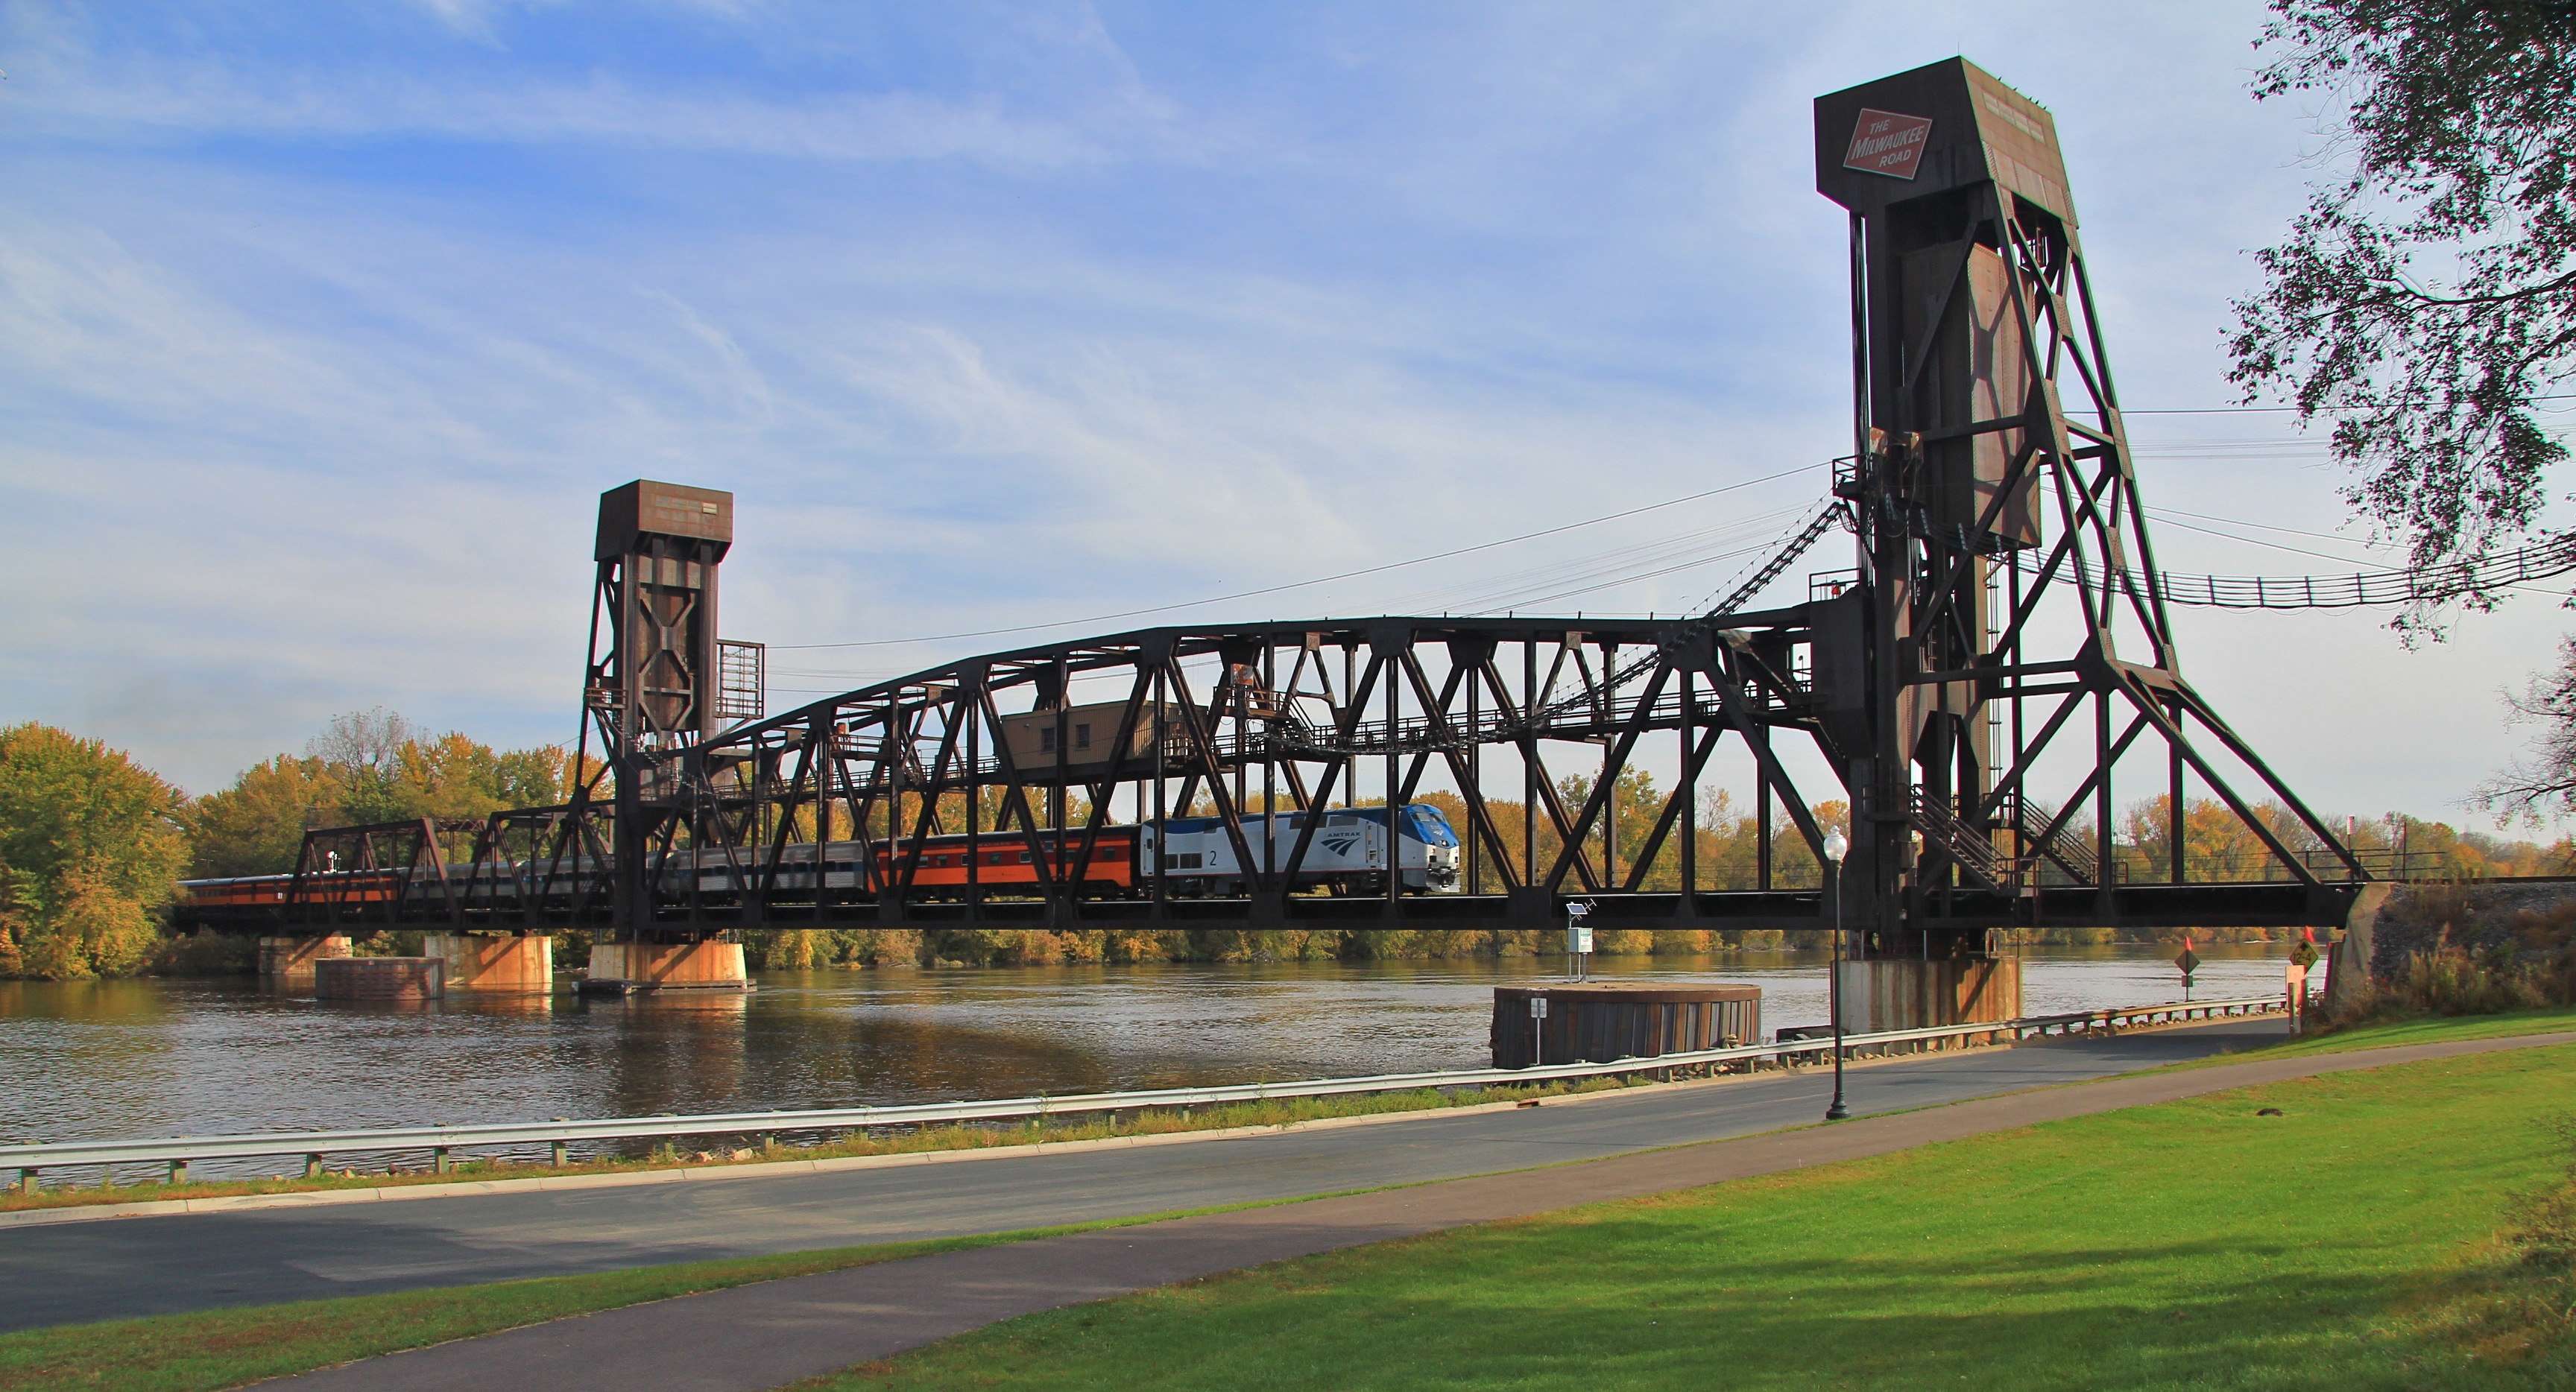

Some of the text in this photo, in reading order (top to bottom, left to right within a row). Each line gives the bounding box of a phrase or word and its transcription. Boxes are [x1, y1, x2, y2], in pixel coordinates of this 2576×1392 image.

[1869, 119, 1890, 134] THE
[1851, 125, 1925, 160] MILWAUKEE
[1878, 149, 1911, 168] ROAD
[1210, 850, 1216, 866] 2
